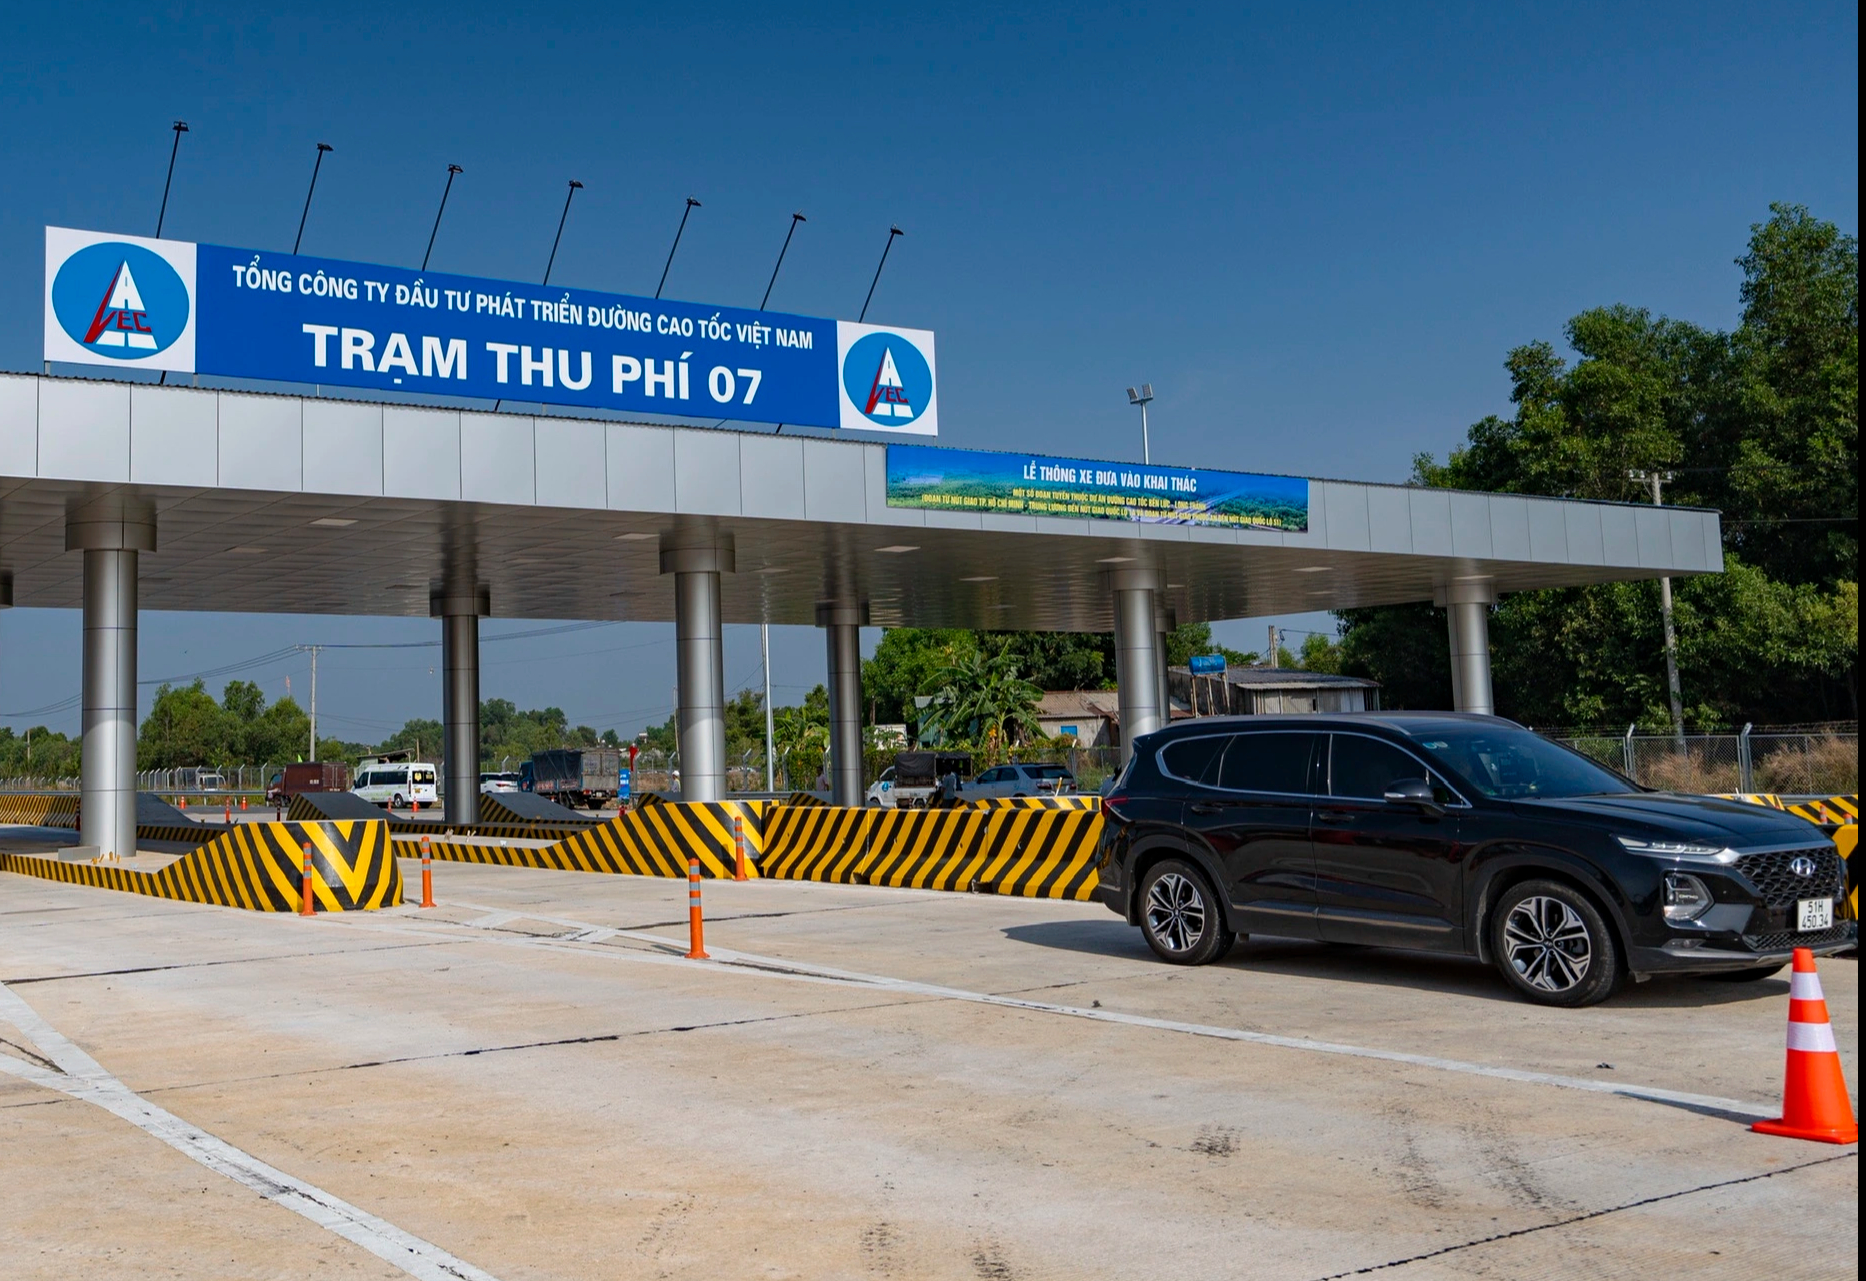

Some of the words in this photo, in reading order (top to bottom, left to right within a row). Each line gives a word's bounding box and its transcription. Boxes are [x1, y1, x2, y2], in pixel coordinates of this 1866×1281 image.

[233, 254, 292, 294] TỔNG
[299, 269, 357, 299] CÔNG
[364, 281, 389, 302] TY
[395, 277, 438, 308] ĐẦU
[445, 289, 471, 311] TƯ
[477, 291, 525, 318] PHÁT
[531, 292, 582, 324] TRIỂN
[588, 303, 651, 332] ĐƯỜNG
[658, 315, 693, 336] CAO
[698, 312, 731, 341] TỐC
[737, 319, 771, 349] VIỆT
[777, 329, 812, 349] NAM
[303, 324, 466, 383] TRẠM
[487, 343, 591, 390] THU
[613, 351, 692, 399] PHÍ
[709, 366, 761, 404] 07
[1024, 460, 1036, 480] LỄ
[1040, 464, 1075, 483] THÔNG
[1080, 470, 1092, 484] XE
[1096, 471, 1117, 486] ĐƯA
[1121, 471, 1140, 488] VÀO
[1144, 475, 1167, 490] KHAI
[1171, 475, 1197, 492] THÁC
[1802, 914, 1828, 928] 450.34
[1808, 901, 1823, 913] 51H
